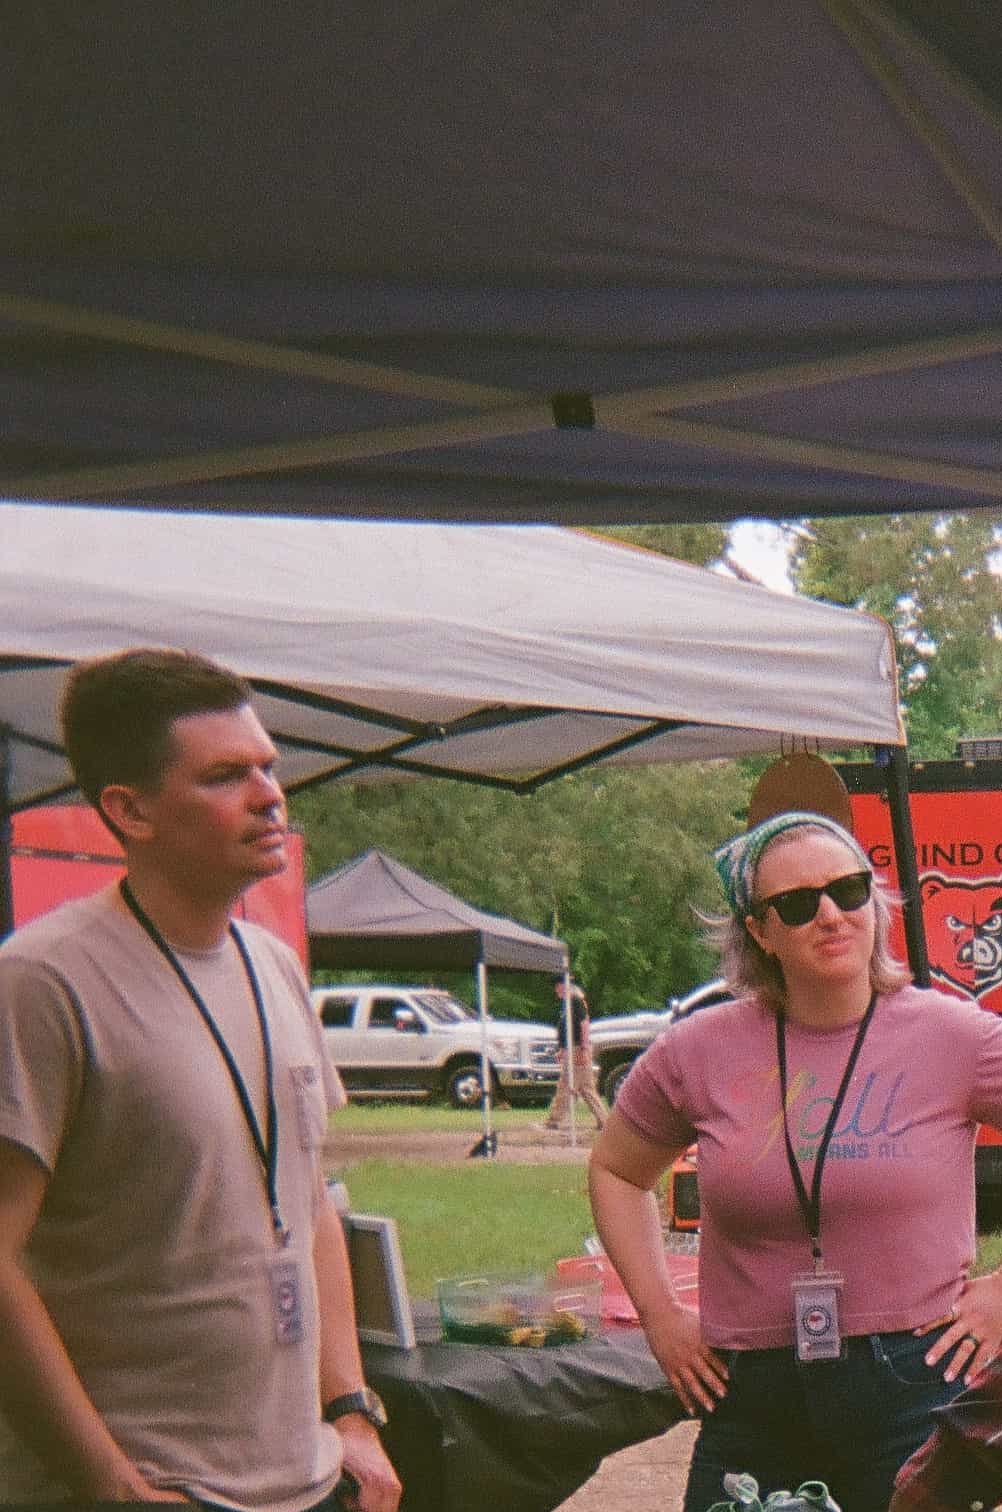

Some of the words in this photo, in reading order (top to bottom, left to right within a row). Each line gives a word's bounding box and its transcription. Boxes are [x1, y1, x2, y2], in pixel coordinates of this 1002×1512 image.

[867, 844, 984, 867] GIND
[796, 1143, 869, 1160] MANS
[878, 1143, 912, 1159] ALL
